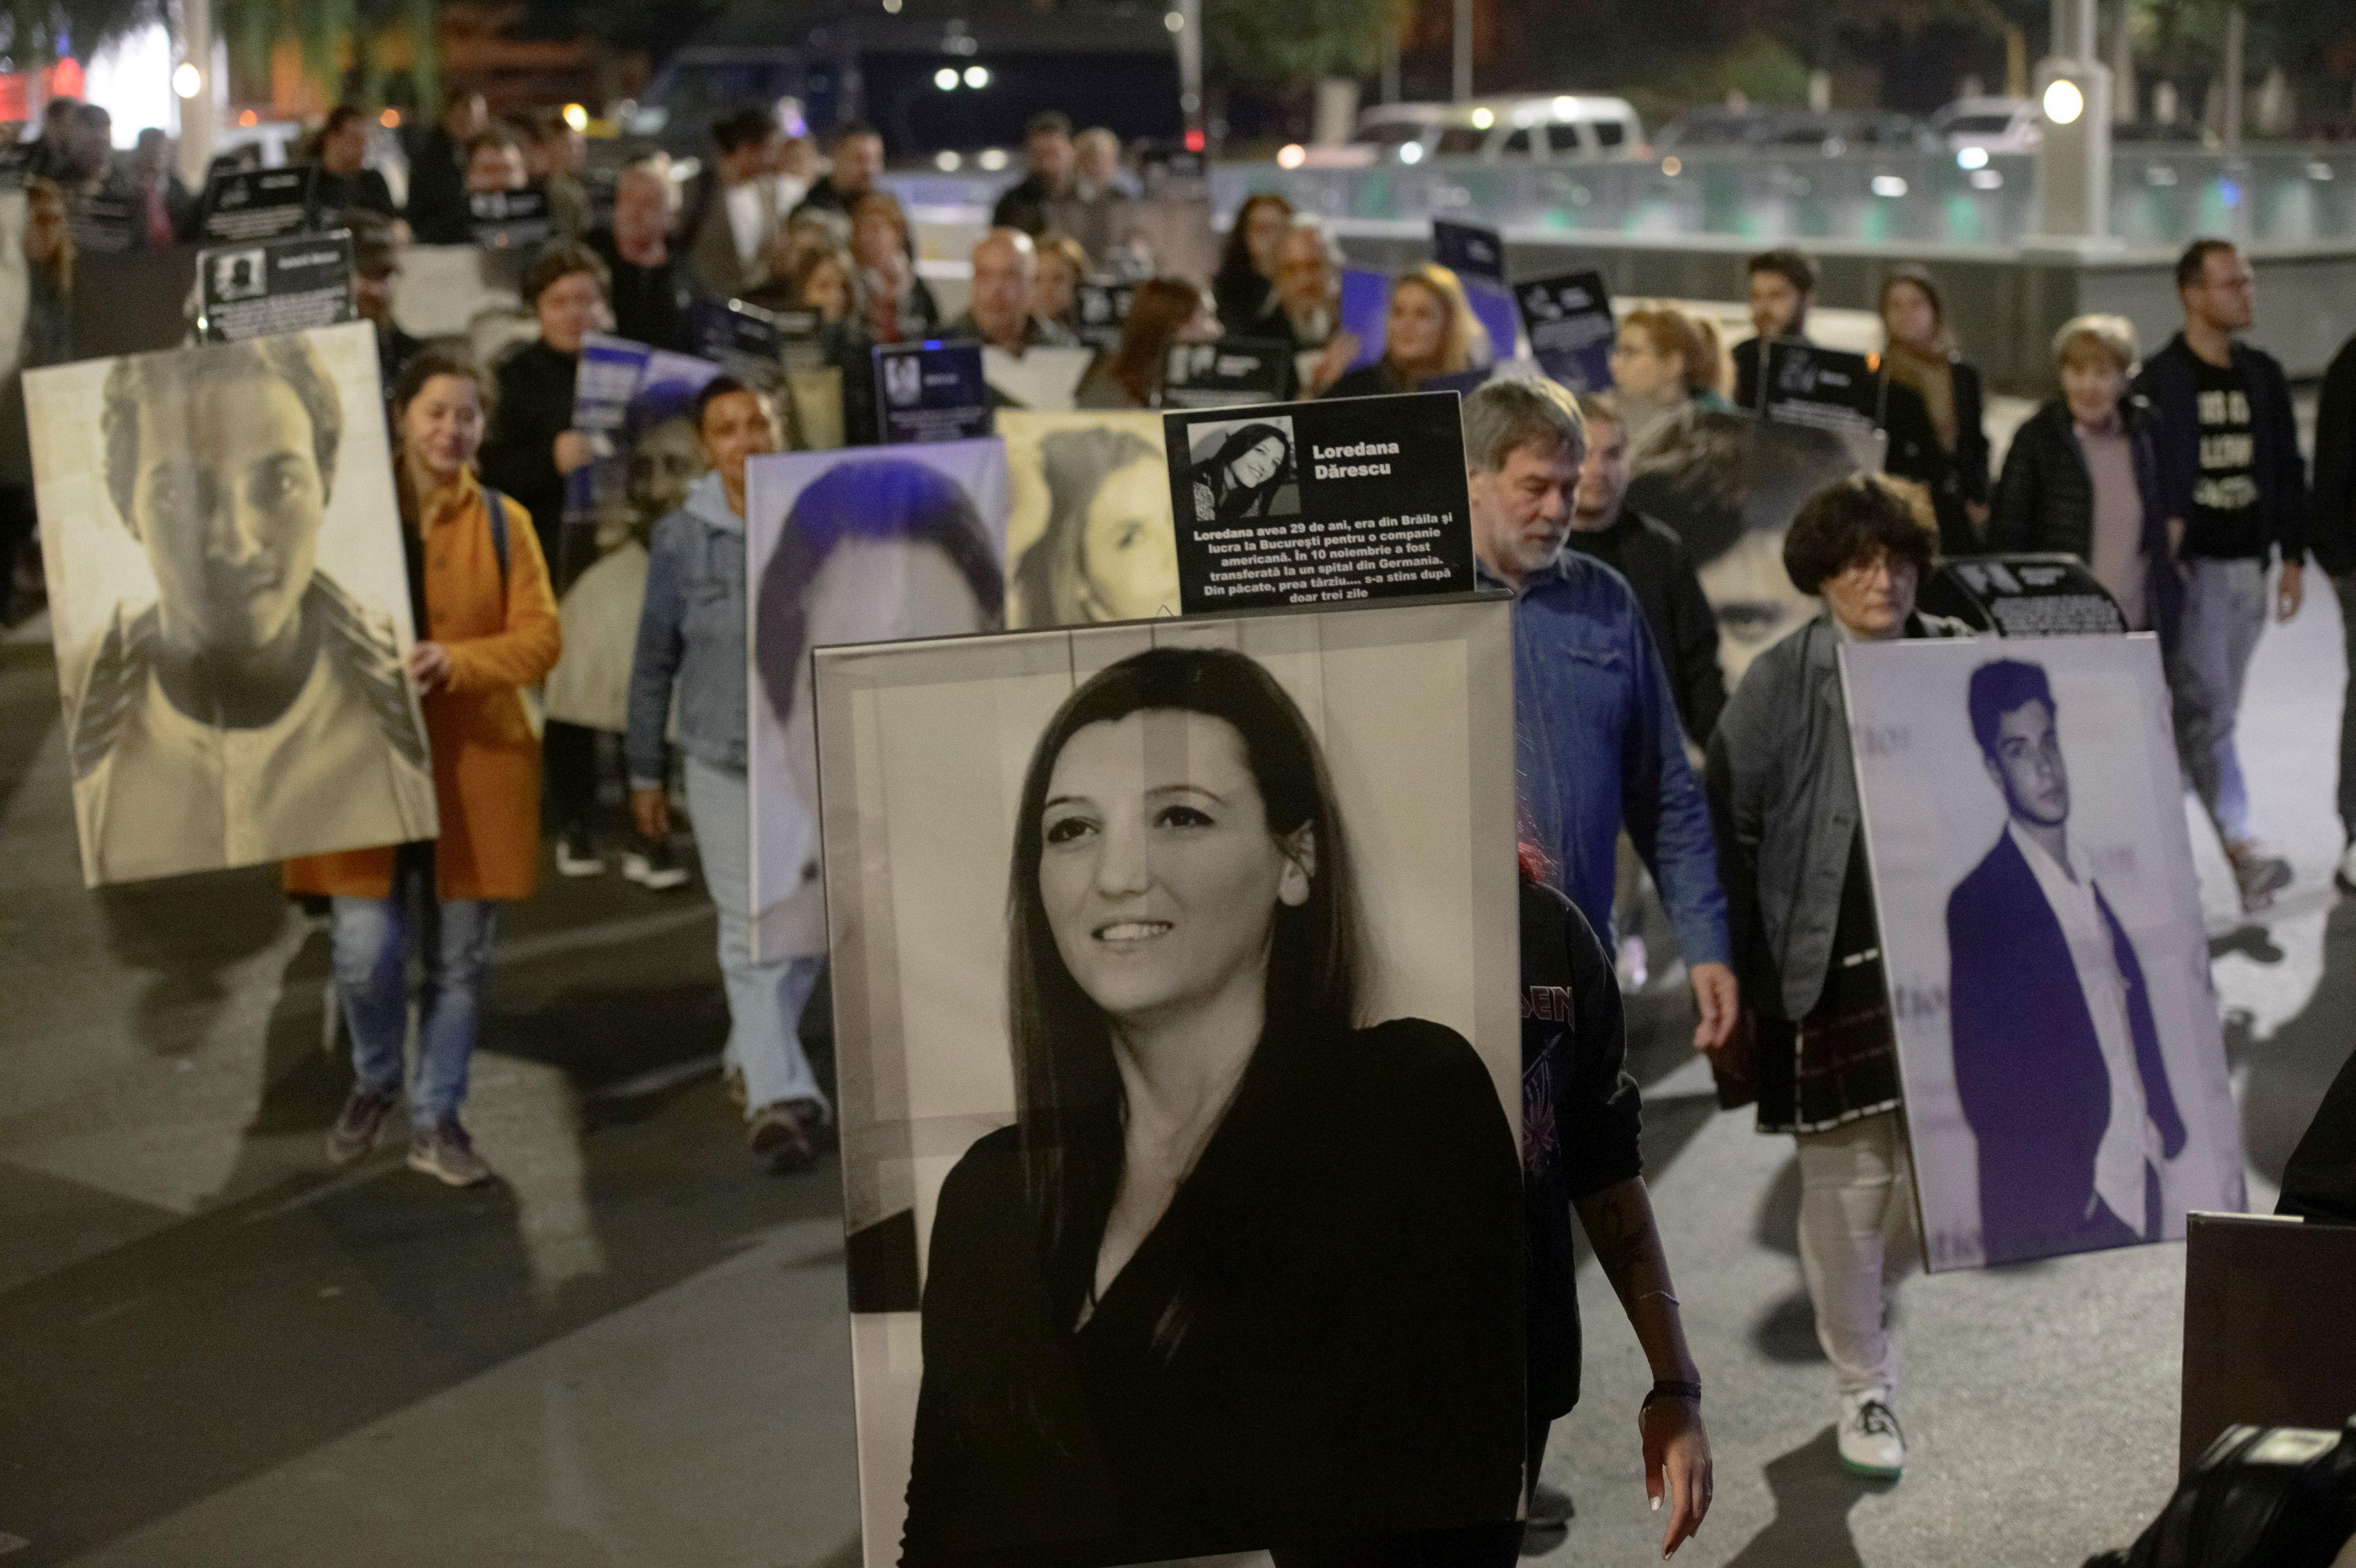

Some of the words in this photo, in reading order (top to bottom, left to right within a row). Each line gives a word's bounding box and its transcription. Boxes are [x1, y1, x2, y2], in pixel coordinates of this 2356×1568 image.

[1312, 442, 1400, 459] Loredana
[1315, 463, 1391, 480] Dărescu
[1194, 529, 1254, 541] Loredana
[1257, 526, 1287, 536] avea
[1290, 524, 1306, 534] 29
[1309, 522, 1325, 532] de
[1328, 520, 1351, 531] ani,
[1355, 520, 1375, 529] era
[1378, 517, 1398, 527] din
[1401, 514, 1438, 526] Brăila
[1208, 543, 1241, 553] lucra
[1244, 541, 1257, 551] la
[1324, 534, 1365, 547] pentru
[1380, 527, 1441, 541] companie
[1221, 552, 1291, 567] americană.
[1311, 549, 1327, 560] 10
[1330, 545, 1392, 558] noiembrie
[1395, 545, 1403, 554] a
[1406, 542, 1431, 553] fost
[1210, 567, 1280, 582] transferată
[1283, 565, 1296, 576] la
[1299, 565, 1315, 575] un
[1318, 561, 1353, 575] spital
[1357, 560, 1376, 571] din
[1379, 556, 1444, 569] Germania.
[1204, 586, 1225, 596] Din
[1228, 582, 1276, 596] păcate,
[1279, 580, 1307, 592] prea
[1387, 571, 1418, 582] stins
[1420, 568, 1452, 580] după
[1289, 593, 1318, 603] doar
[1321, 590, 1343, 601] trei
[1346, 588, 1368, 599] zile
